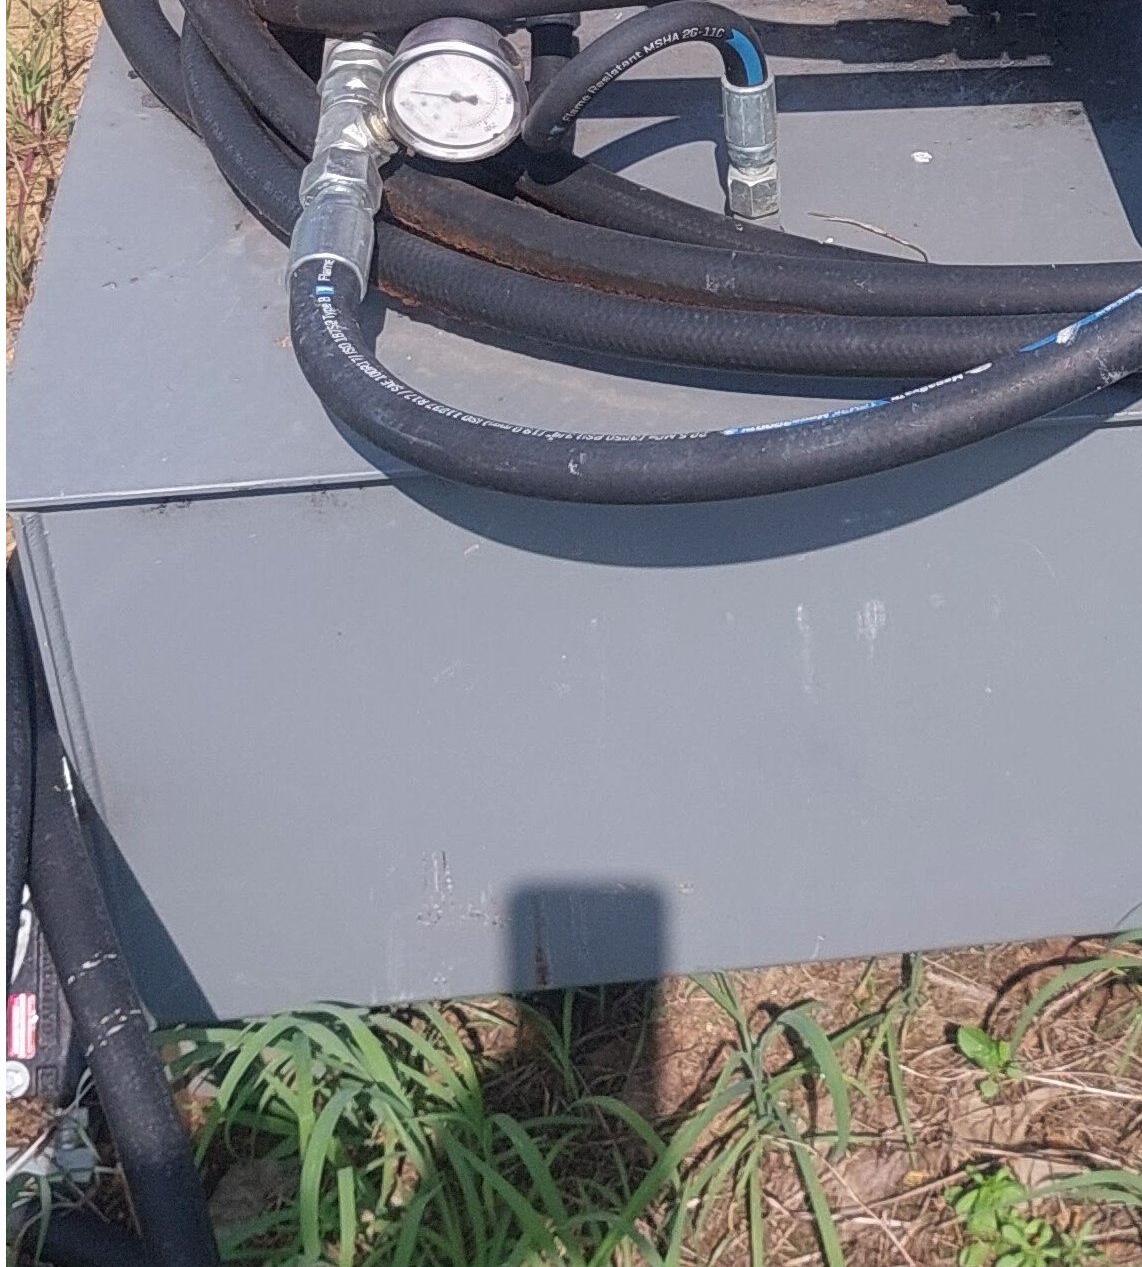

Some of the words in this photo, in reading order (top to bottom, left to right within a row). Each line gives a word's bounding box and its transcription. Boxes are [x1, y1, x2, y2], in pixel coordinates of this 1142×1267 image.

[561, 94, 593, 123] Flame
[587, 50, 644, 94] Resistant
[643, 31, 680, 55] MSHA
[681, 26, 726, 40] 2G-11C
[317, 258, 335, 282] Flame
[321, 303, 338, 321] Type
[338, 341, 358, 355] ISO
[350, 356, 388, 383] 100R17
[379, 377, 405, 393] SAE
